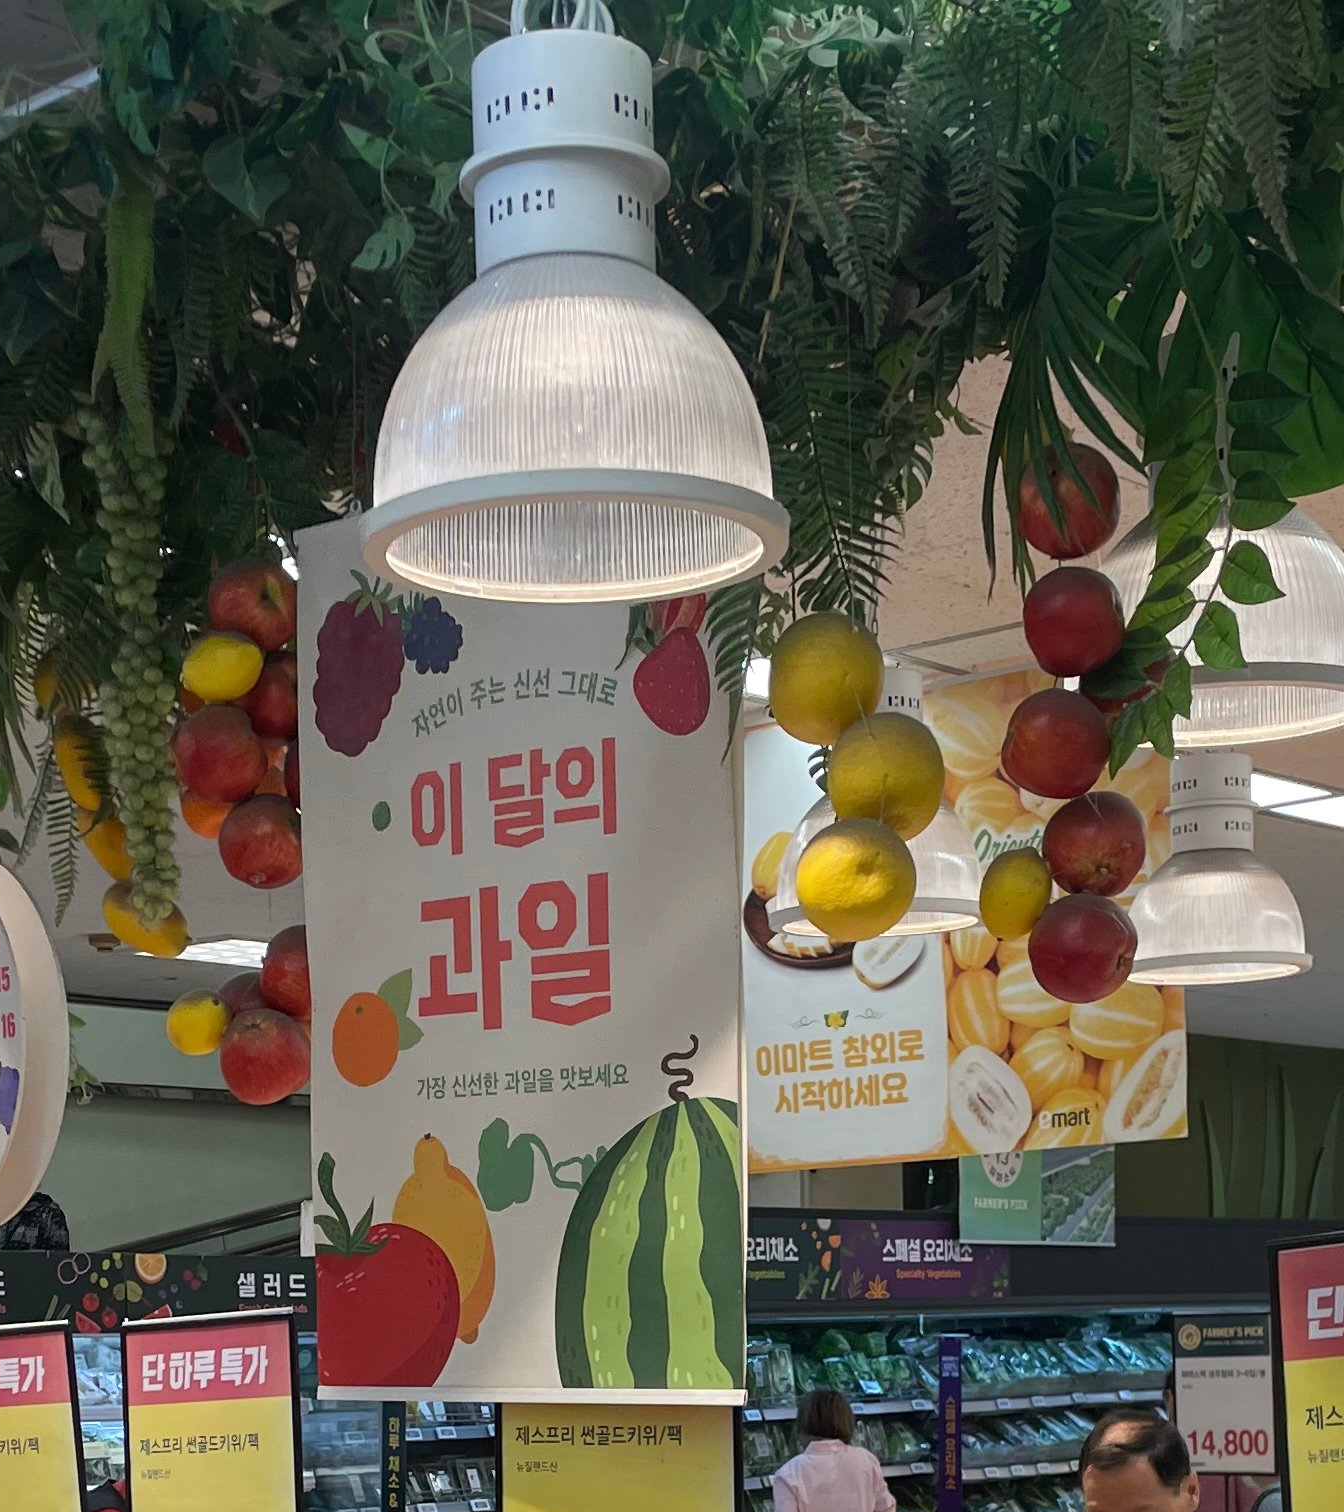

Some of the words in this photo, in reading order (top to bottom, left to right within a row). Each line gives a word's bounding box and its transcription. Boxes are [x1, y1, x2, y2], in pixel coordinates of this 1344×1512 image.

[412, 688, 463, 738] 자연이
[470, 675, 505, 706] 주는
[512, 668, 549, 700] 신선
[560, 670, 618, 706] 그대로
[411, 761, 463, 855] 이
[487, 736, 617, 848] 달의
[418, 872, 612, 1031] 과일
[1, 1013, 16, 1039] 16
[755, 1036, 835, 1077] 이마트
[842, 1029, 925, 1069] 참외로
[416, 1076, 446, 1101] 가장
[452, 1072, 499, 1096] 신선한
[504, 1067, 554, 1095] 과일을
[560, 1063, 629, 1091] 맛보세요
[774, 1072, 909, 1115] 시작하세요
[1039, 1108, 1091, 1130] emart
[746, 1237, 799, 1262] 요리채소
[882, 1238, 921, 1262] 스페셜
[923, 1239, 973, 1263] 요리채소
[236, 1272, 308, 1300] 샐러드
[1202, 1327, 1243, 1338] FARMER'S
[1244, 1326, 1264, 1337] PICK
[142, 1355, 165, 1392] 단
[168, 1352, 215, 1390] 하루
[220, 1345, 268, 1384] 특가
[139, 1436, 182, 1456] 제스프리
[186, 1433, 259, 1454] 썬골드키위/팩
[515, 1426, 574, 1445] 제스프리
[580, 1425, 683, 1446] 썬골드키위/팩
[1188, 1429, 1268, 1459] 14,800
[516, 1461, 558, 1473] 뉴질랜드산
